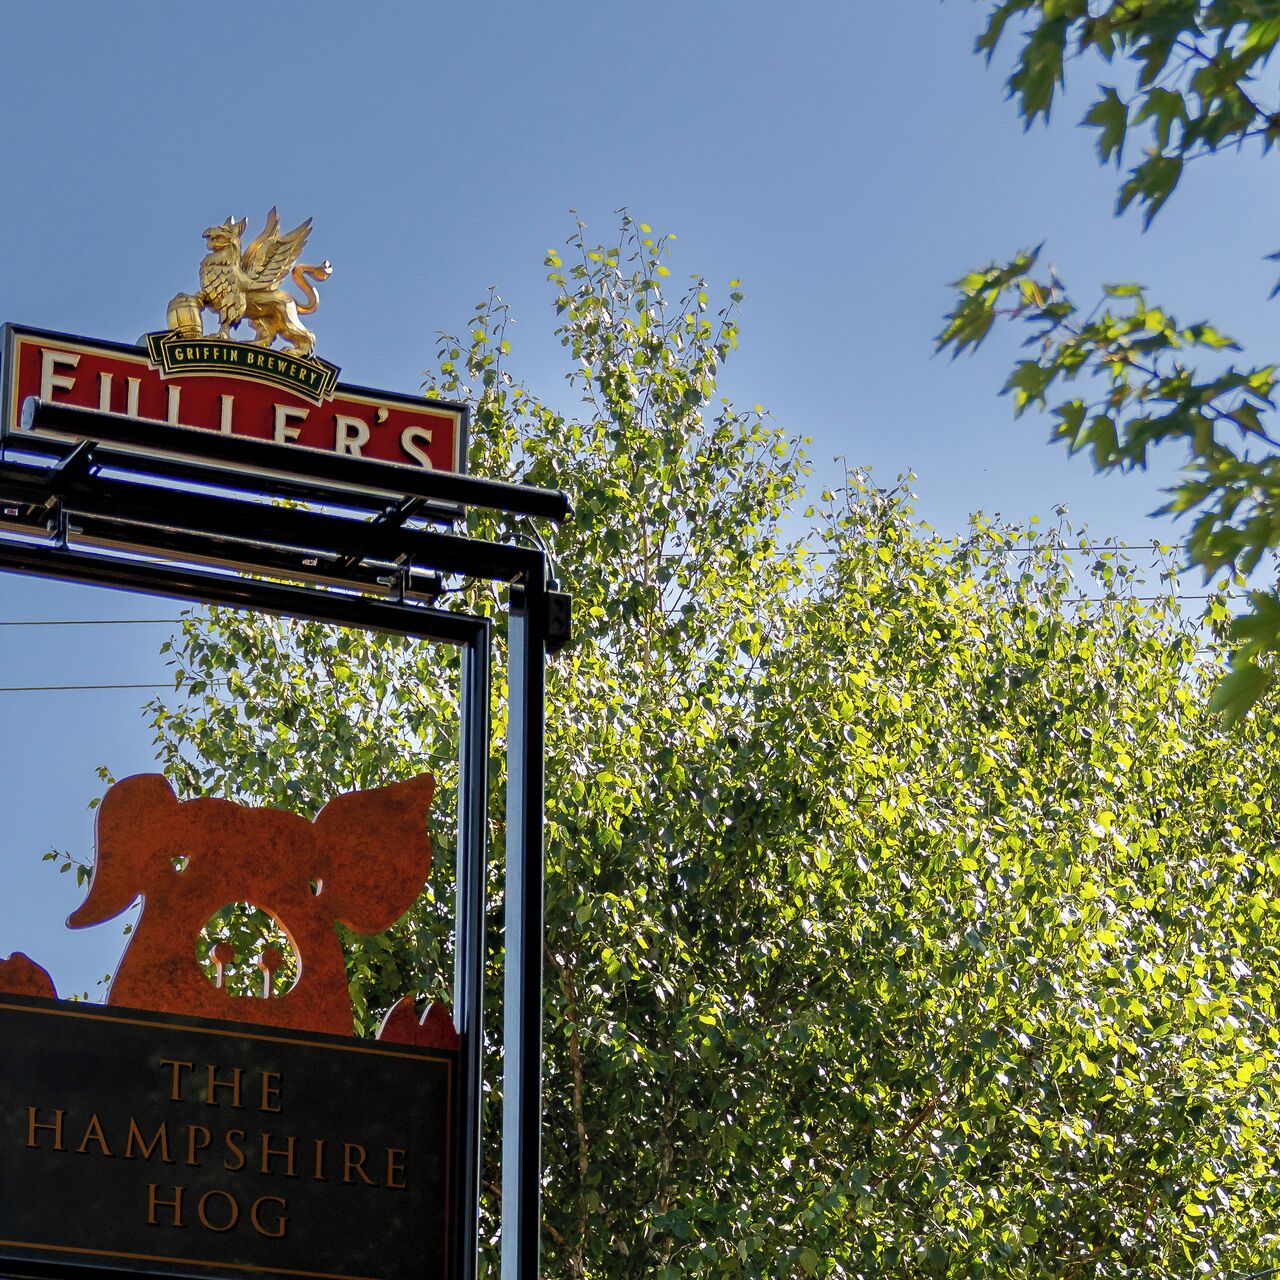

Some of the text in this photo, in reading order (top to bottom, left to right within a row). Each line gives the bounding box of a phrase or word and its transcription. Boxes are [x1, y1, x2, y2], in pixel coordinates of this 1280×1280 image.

[175, 347, 317, 385] GRIFFIN BREWERY
[159, 1058, 281, 1112] THE
[25, 1106, 407, 1188] HAMPSHIRE
[146, 1183, 290, 1237] HOG
